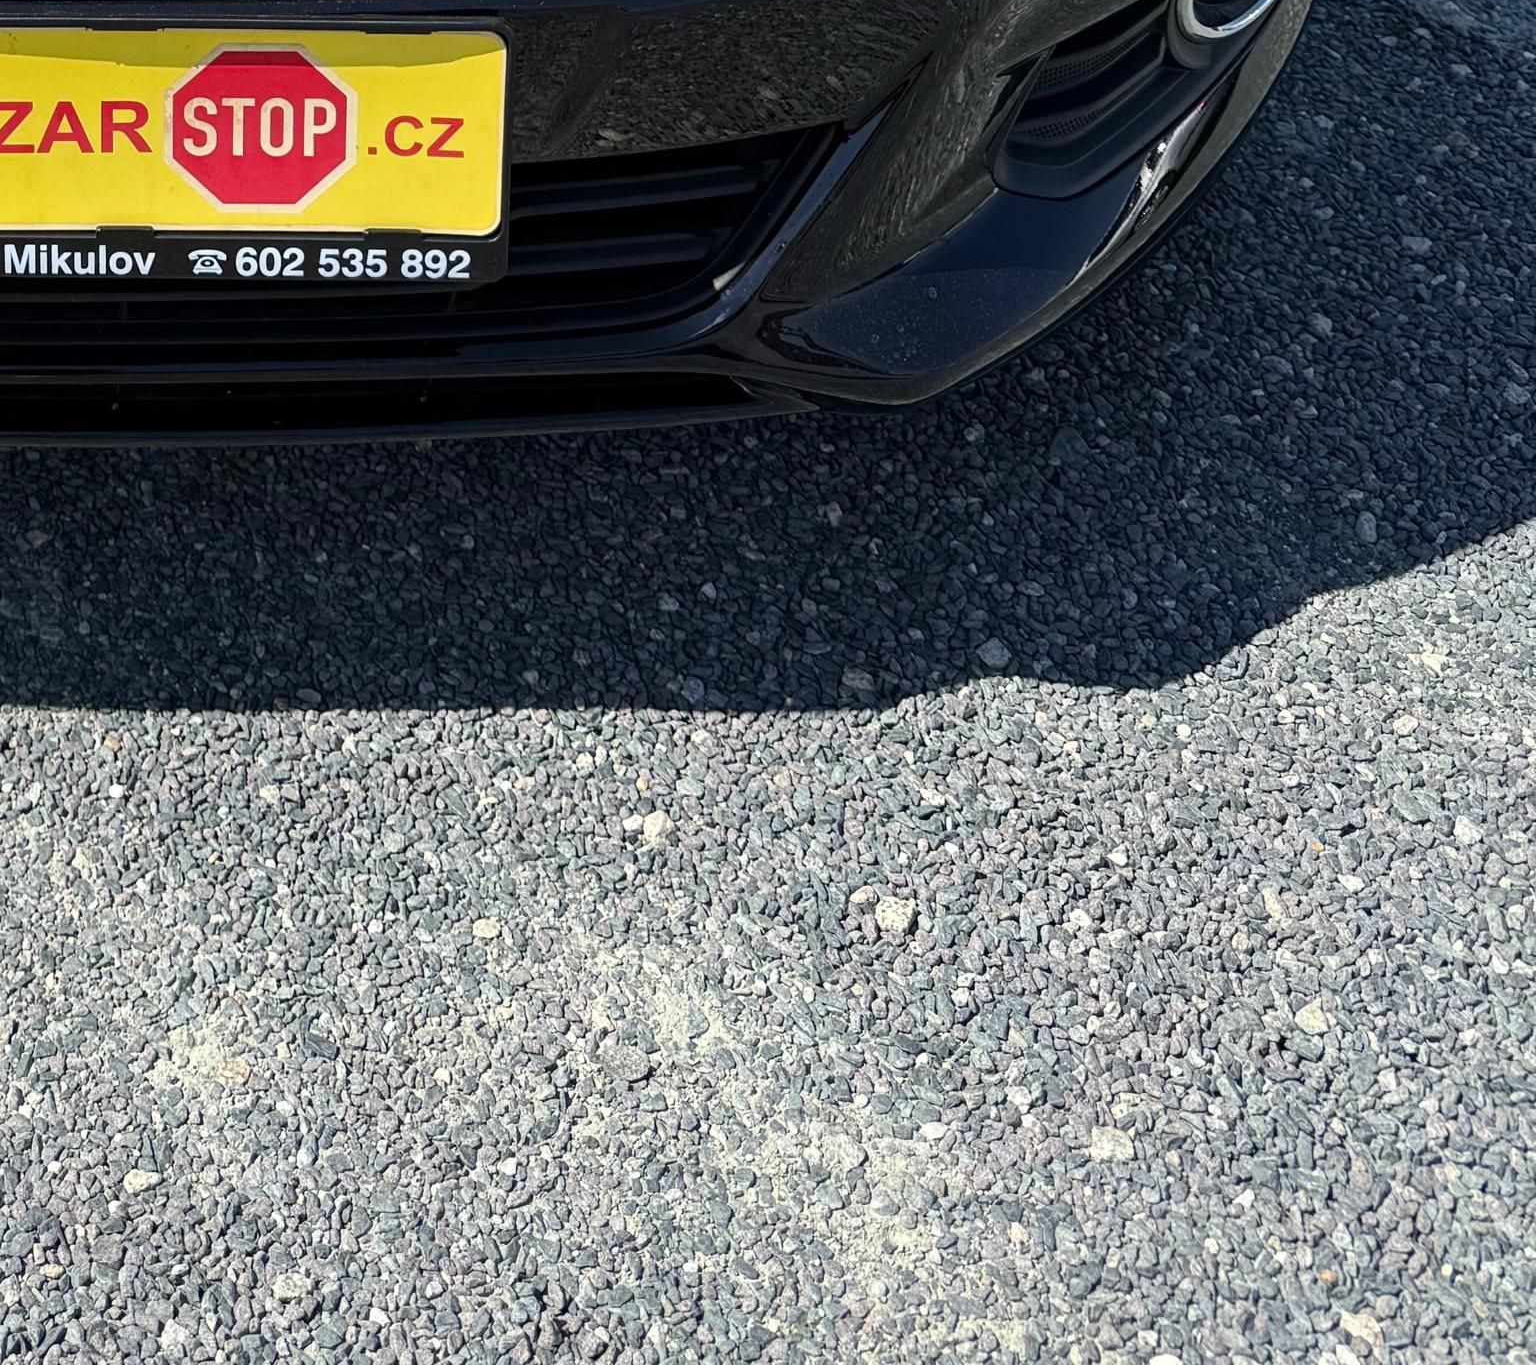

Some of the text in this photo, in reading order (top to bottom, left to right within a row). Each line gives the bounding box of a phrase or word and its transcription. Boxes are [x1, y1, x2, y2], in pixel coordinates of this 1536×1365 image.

[182, 97, 337, 158] STOP
[4, 244, 156, 275] Mikulov
[235, 247, 305, 278] 602
[318, 248, 388, 278] 535
[400, 249, 472, 279] 892
